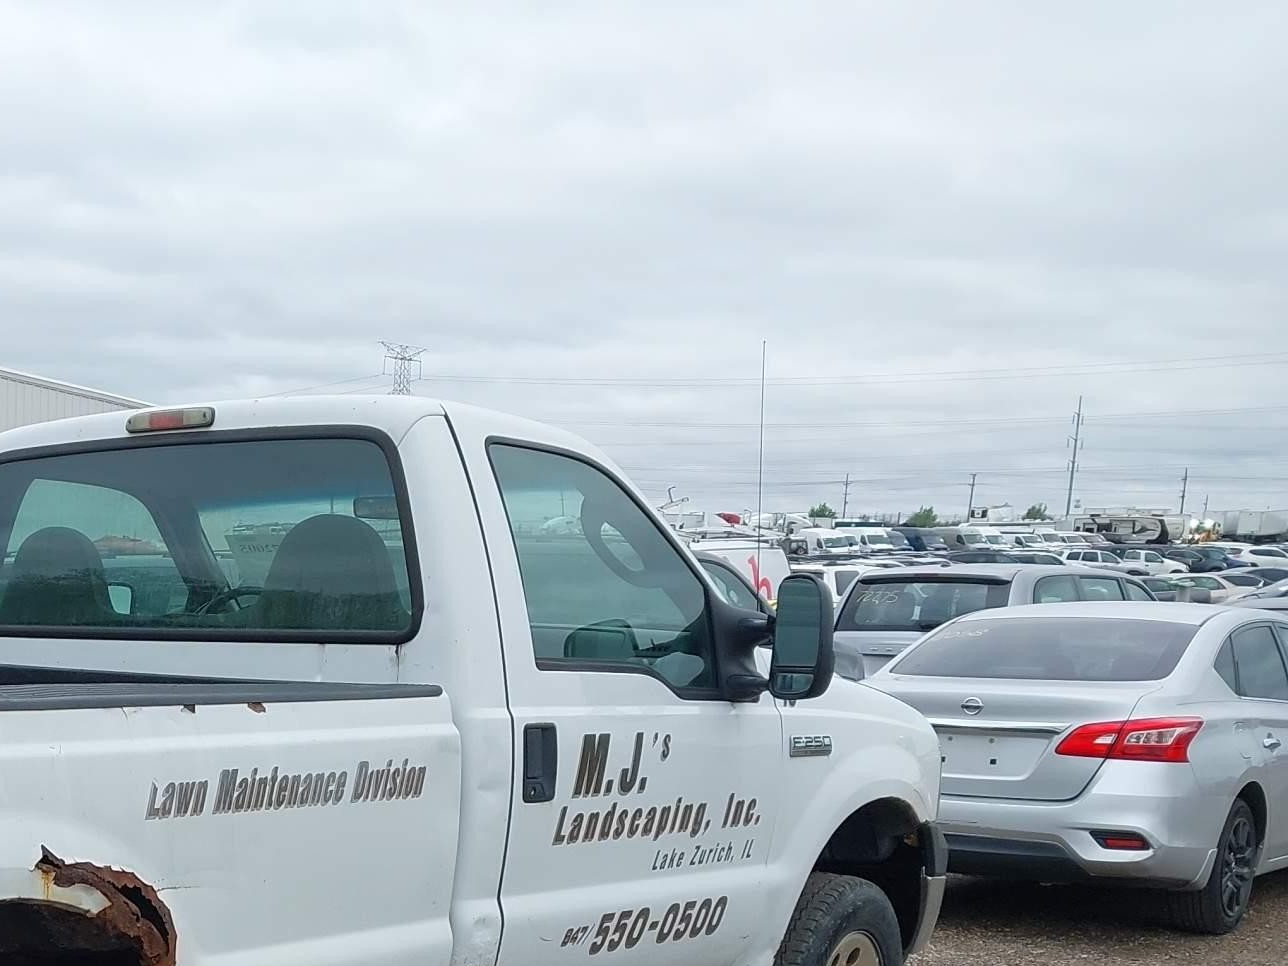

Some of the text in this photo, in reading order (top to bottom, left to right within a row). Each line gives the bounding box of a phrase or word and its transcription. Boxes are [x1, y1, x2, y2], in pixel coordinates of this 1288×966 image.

[144, 758, 427, 820] Lawn Maintenance Division
[571, 732, 672, 799] M.J.'s
[552, 793, 761, 846] Landscaping, Inc.
[651, 839, 756, 871] Lake Zurich, IL
